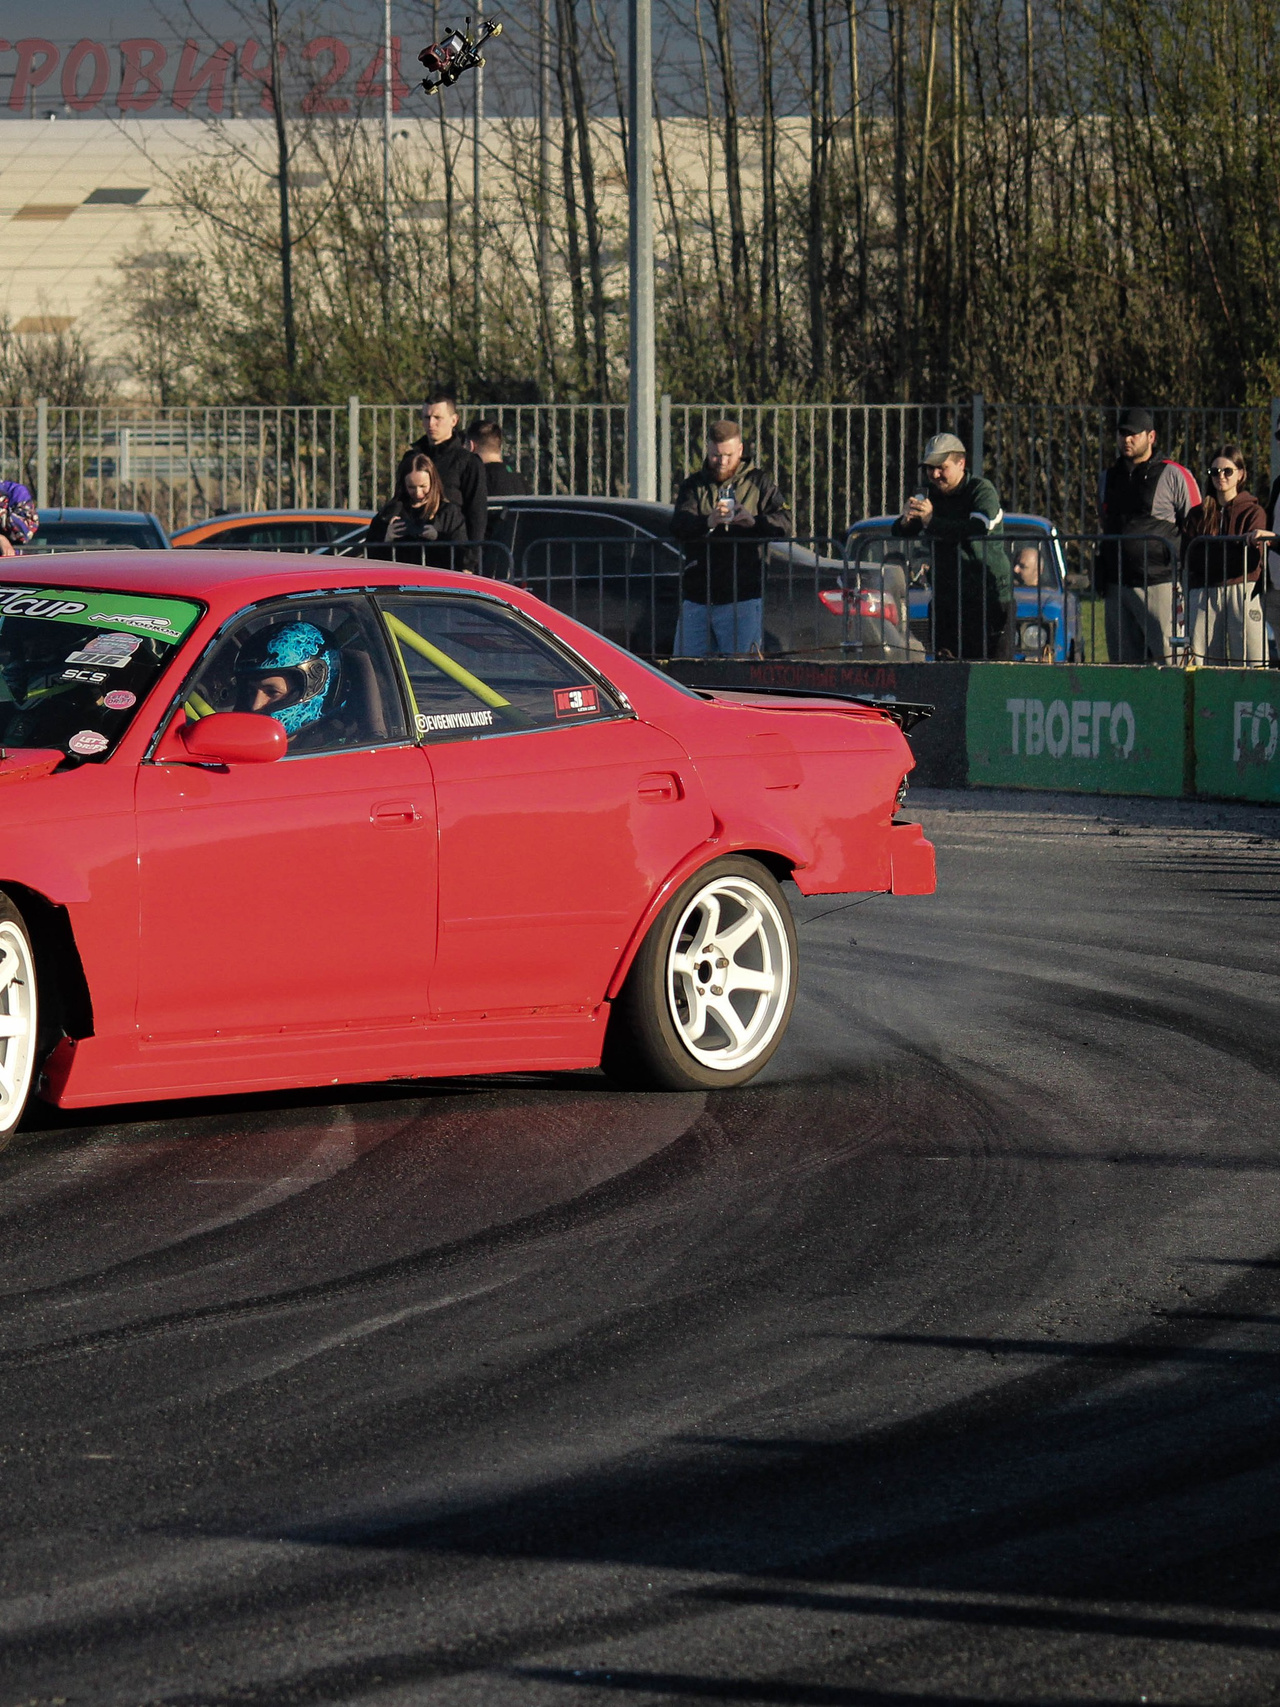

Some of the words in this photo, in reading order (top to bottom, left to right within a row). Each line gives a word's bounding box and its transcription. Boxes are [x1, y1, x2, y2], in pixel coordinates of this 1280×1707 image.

[1, 599, 86, 617] CUP
[61, 668, 107, 682] SCS
[1006, 699, 1135, 759] ТВОЕГО
